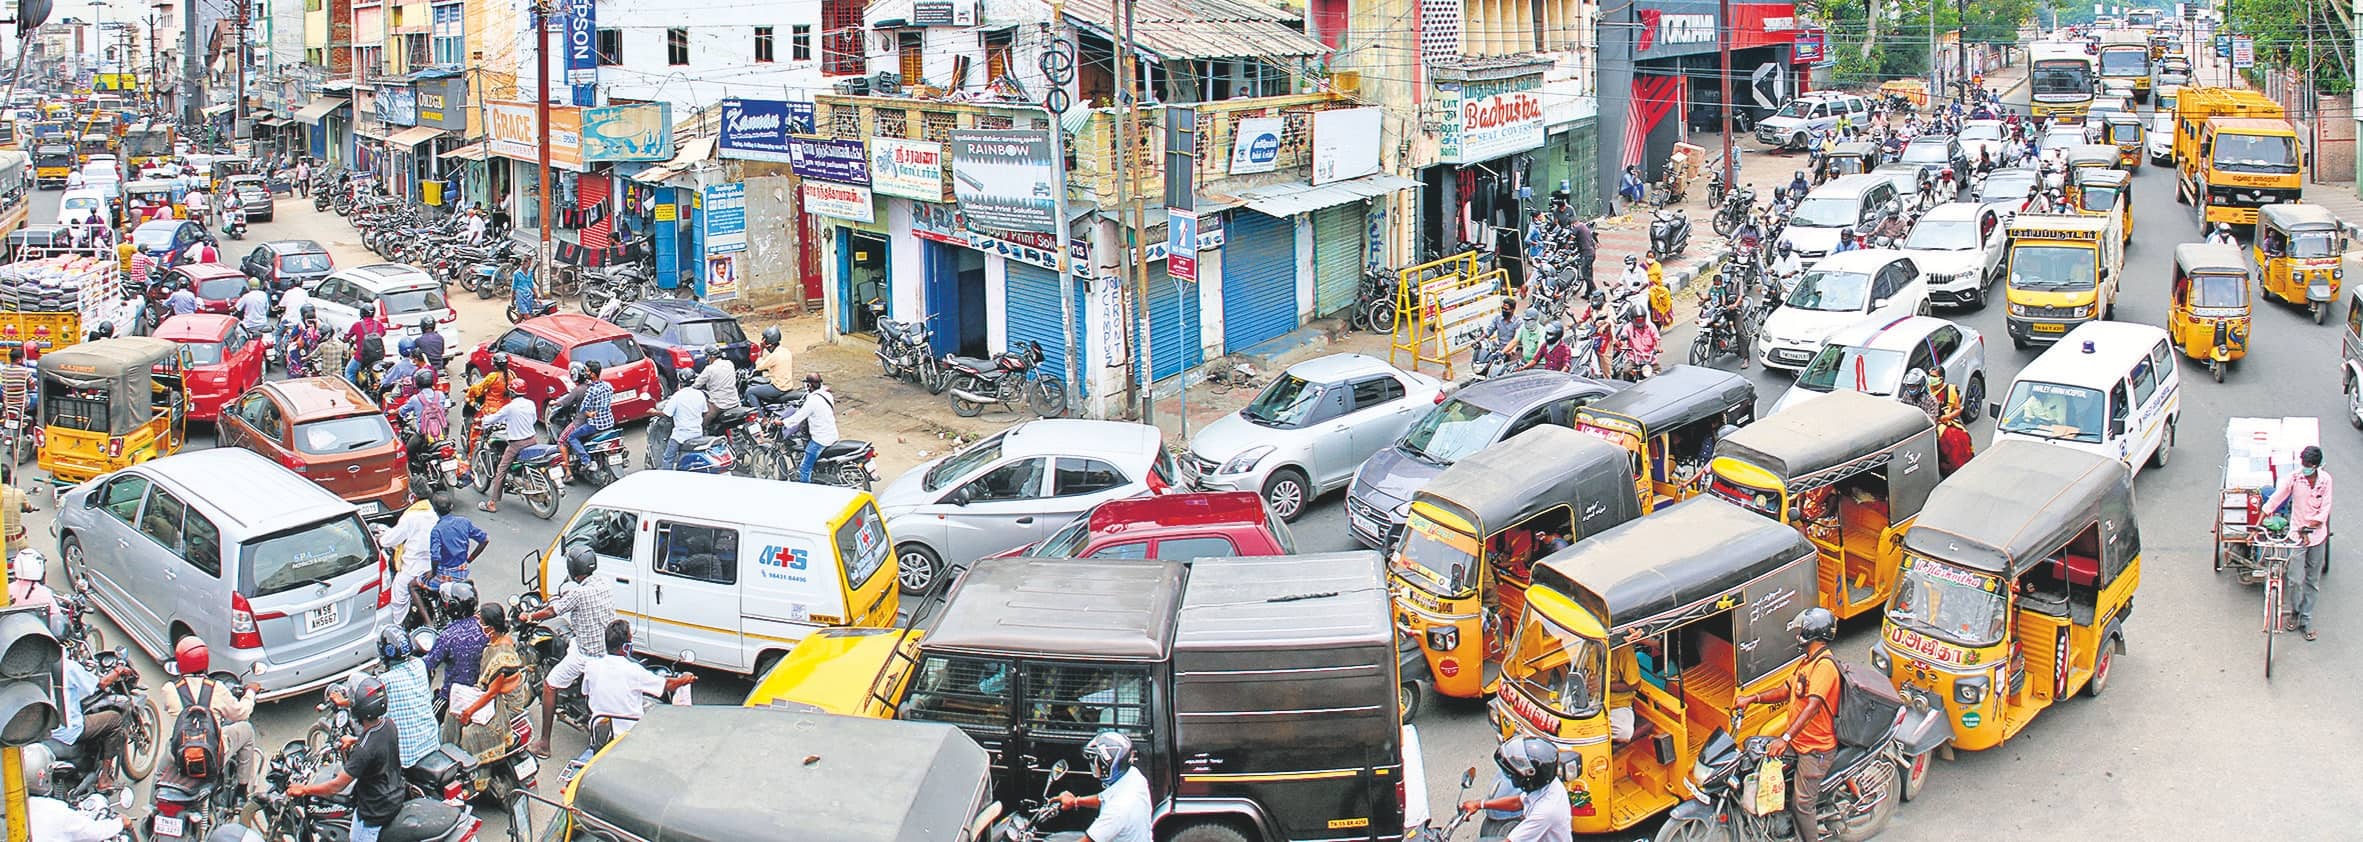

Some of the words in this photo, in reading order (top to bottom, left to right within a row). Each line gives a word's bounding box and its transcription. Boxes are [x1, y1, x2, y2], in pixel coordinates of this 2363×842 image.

[493, 107, 532, 142] GRACE
[968, 143, 1029, 156] RAINBOW
[995, 205, 1011, 213] Print
[1012, 207, 1045, 216] Solutions
[1011, 231, 1035, 246] Print
[313, 608, 322, 617] TN
[1891, 628, 1963, 664] ப.அஜிதா
